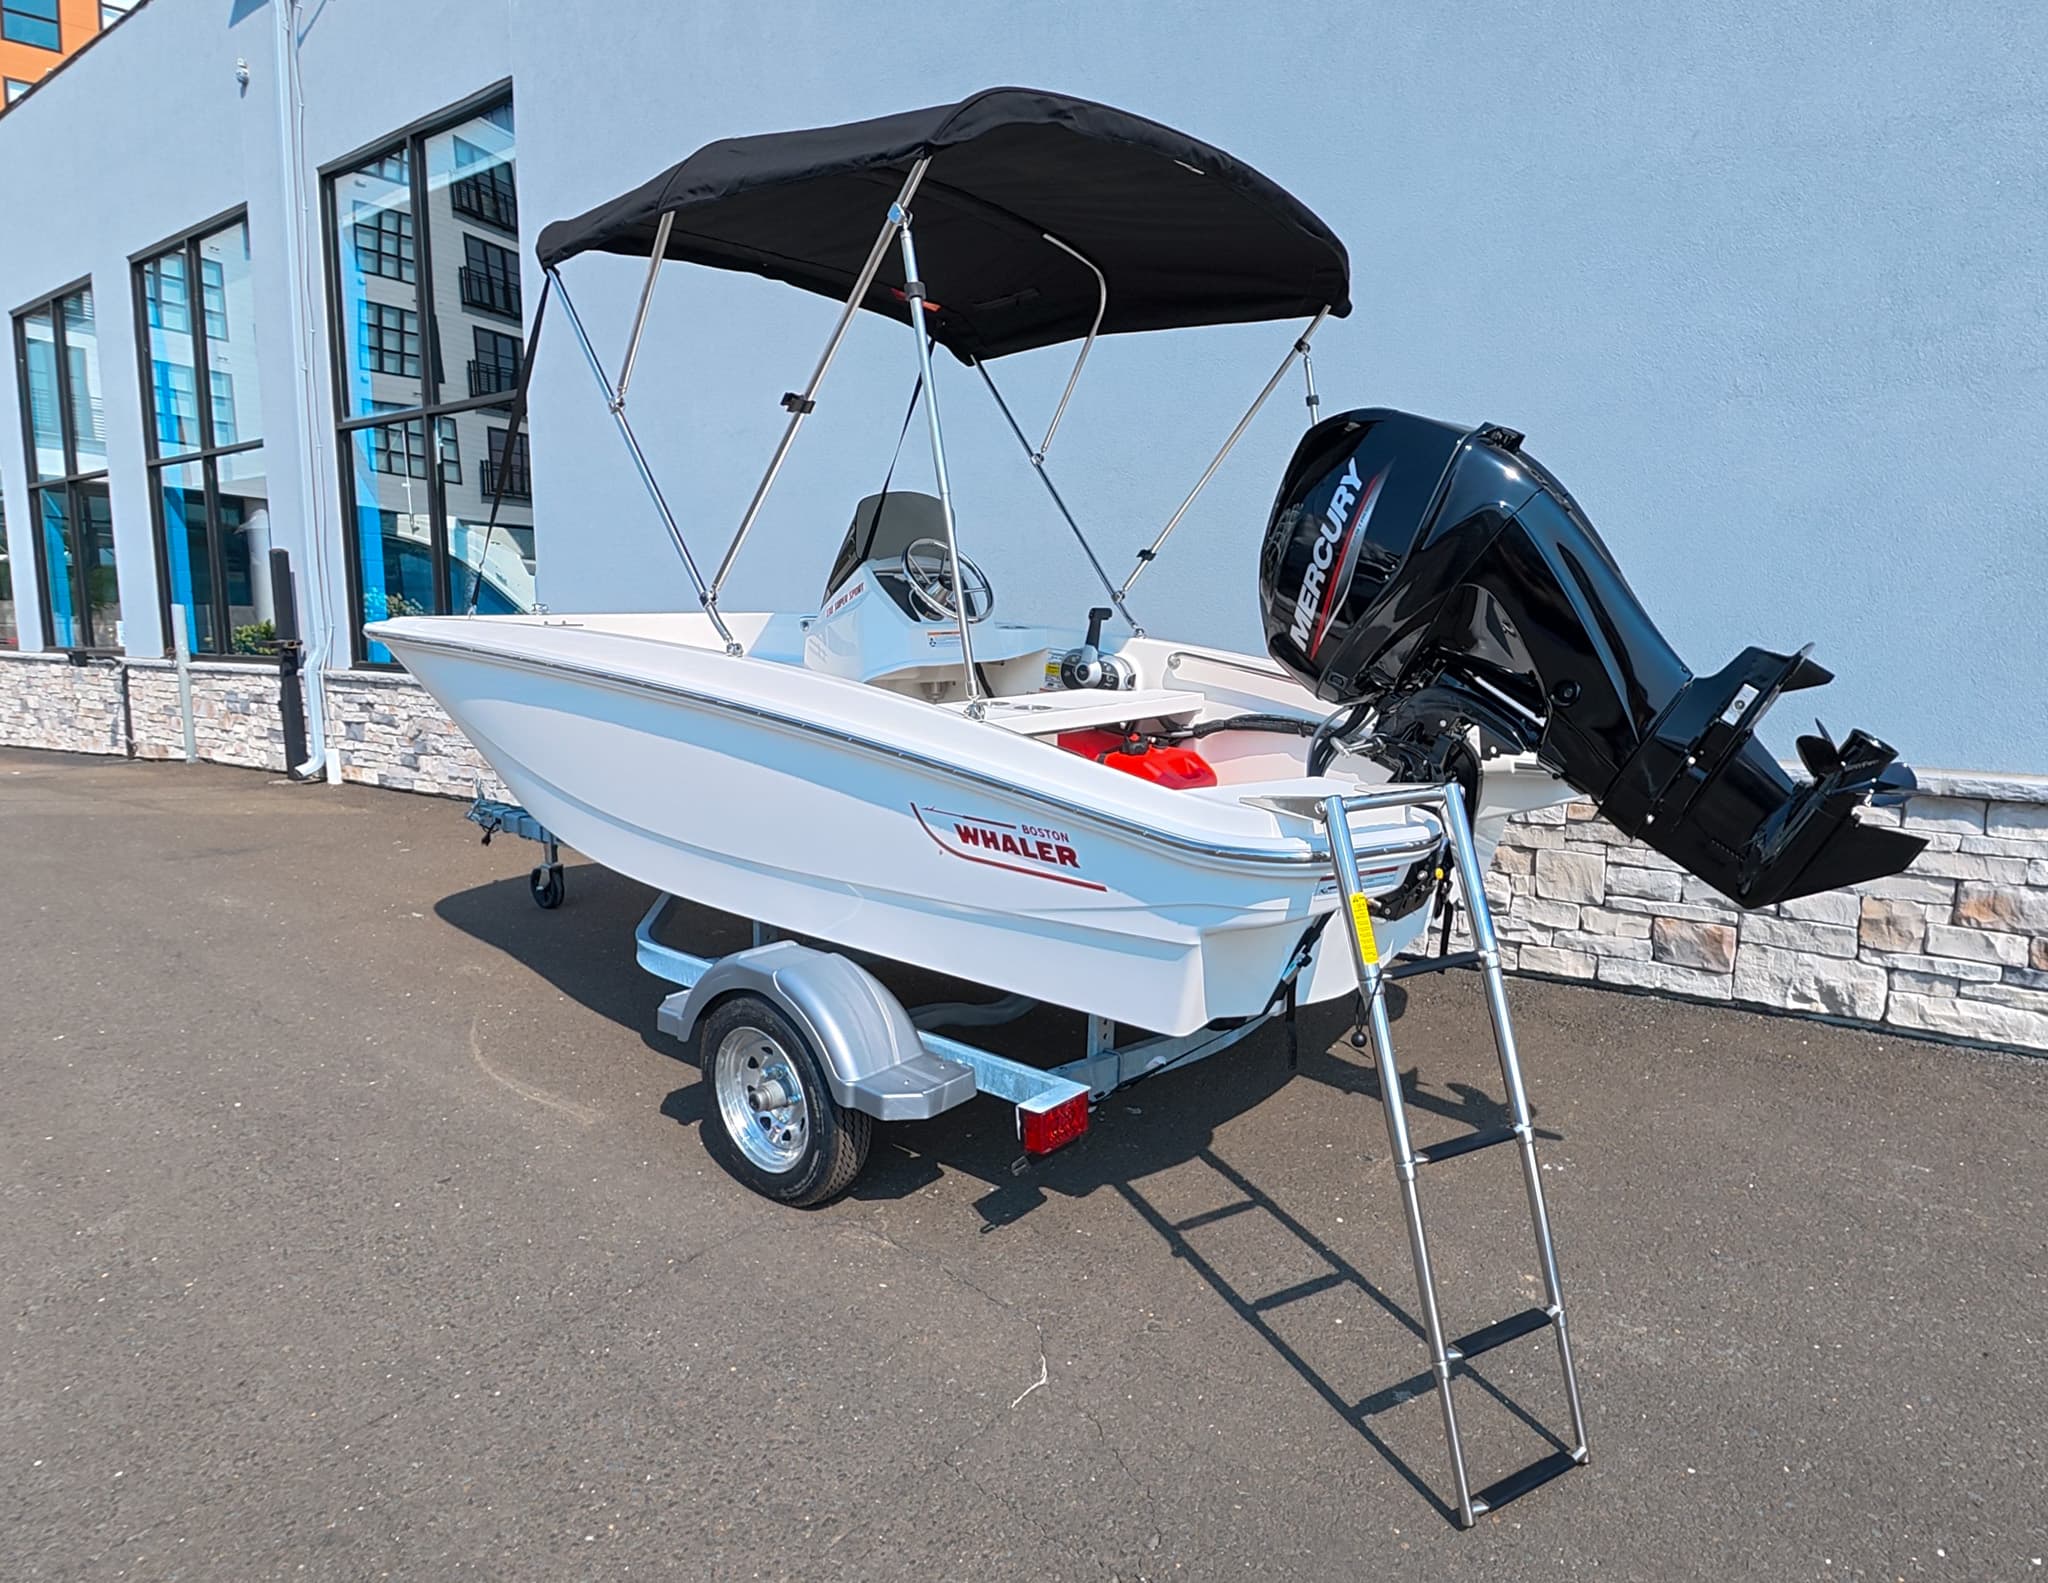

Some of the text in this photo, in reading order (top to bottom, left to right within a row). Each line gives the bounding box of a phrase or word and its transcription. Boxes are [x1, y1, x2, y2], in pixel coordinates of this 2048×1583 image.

[1289, 457, 1362, 651] MERCURY
[953, 823, 1081, 868] WHALER
[1021, 824, 1070, 842] BOSTON
